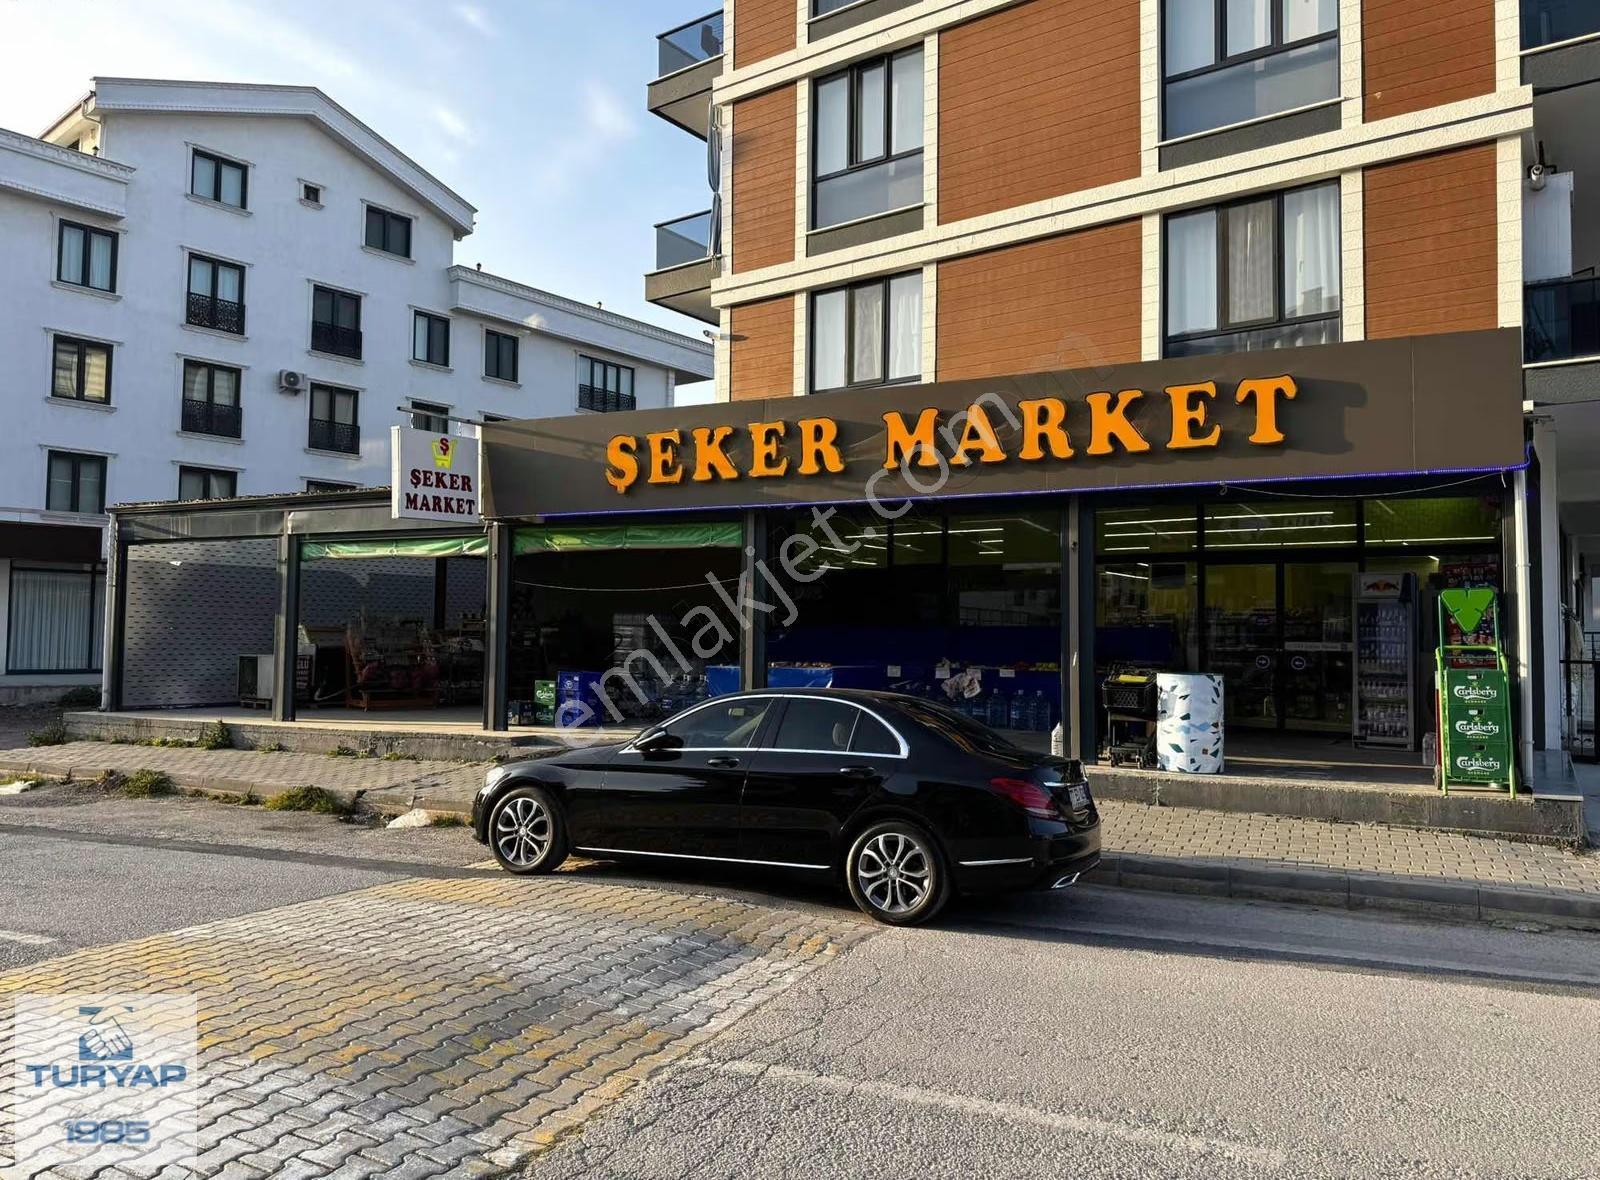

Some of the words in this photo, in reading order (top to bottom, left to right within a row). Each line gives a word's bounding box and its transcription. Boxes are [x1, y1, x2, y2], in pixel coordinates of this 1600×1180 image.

[604, 416, 846, 494] ŞEKER
[881, 374, 1298, 469] MARKET
[410, 468, 472, 492] ŞEKER
[405, 492, 475, 515] MARKET
[1453, 685, 1497, 699] Carlsberg
[1455, 720, 1499, 735] Carlsberg
[1456, 756, 1500, 771] Carlsberg
